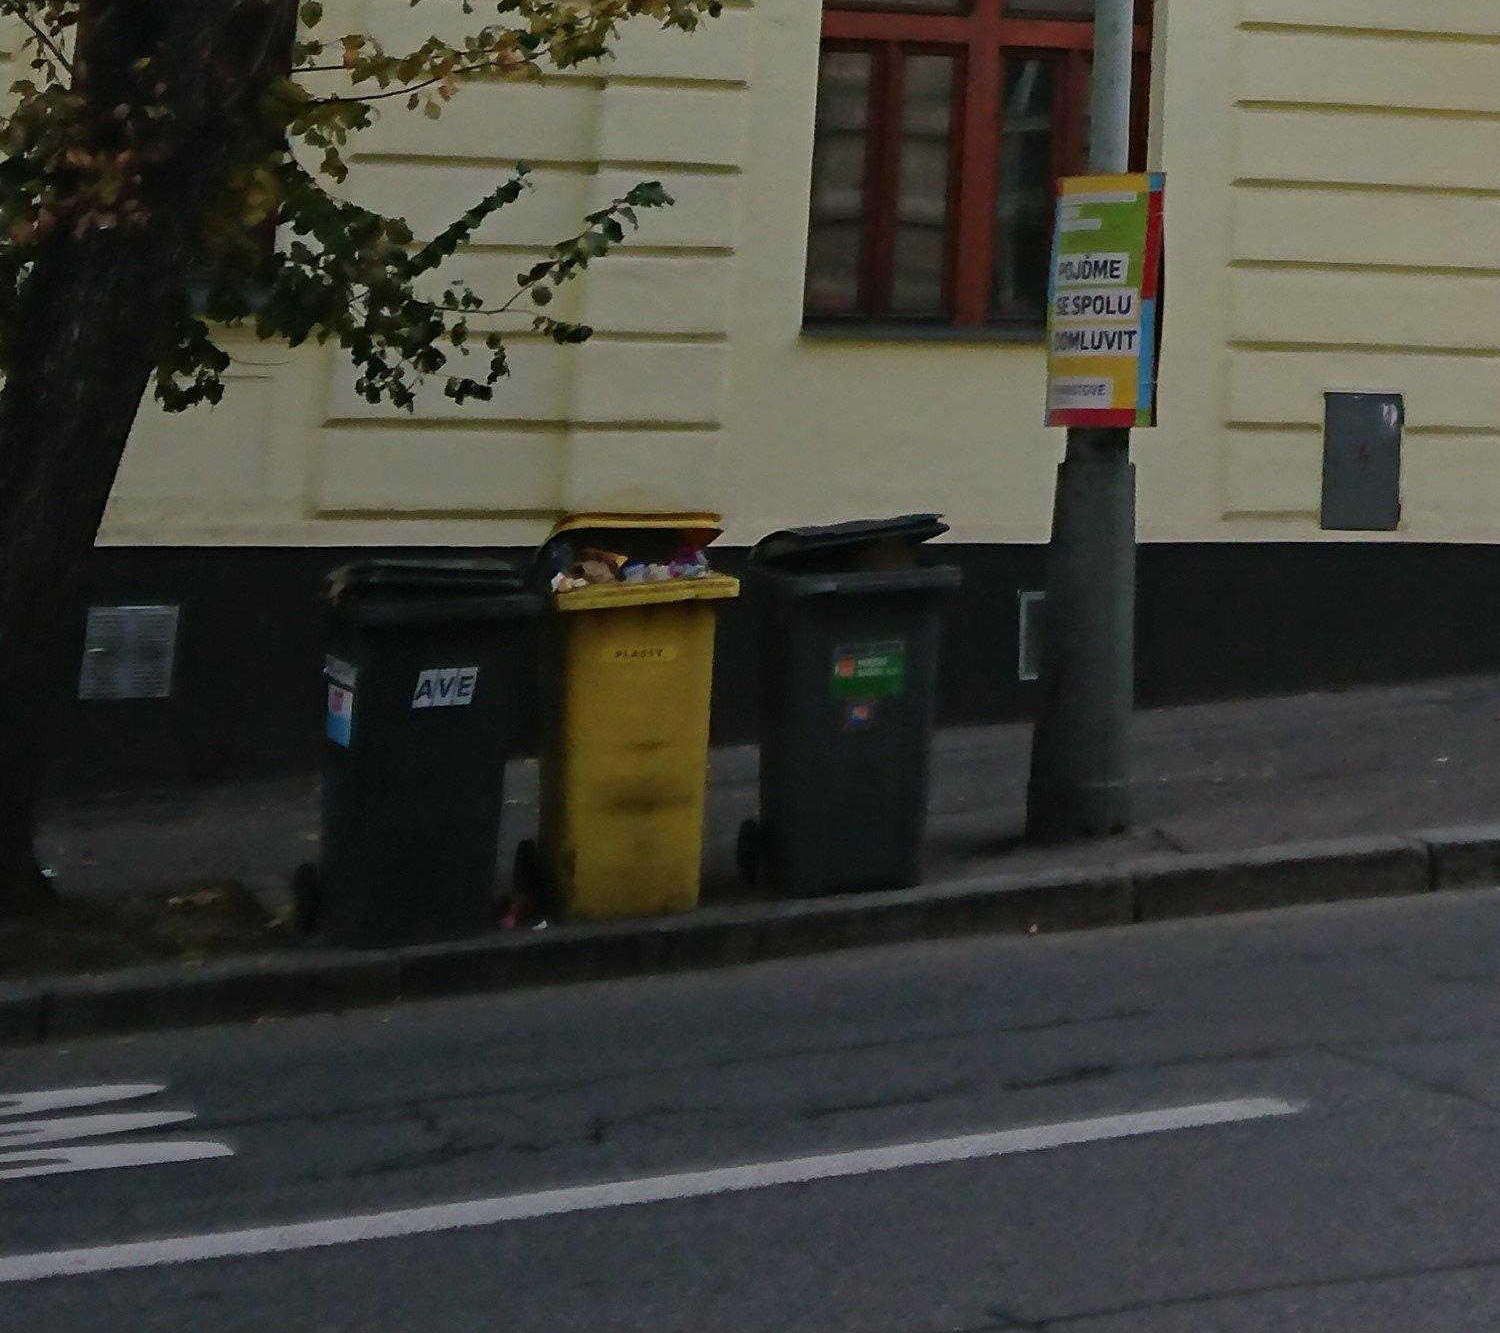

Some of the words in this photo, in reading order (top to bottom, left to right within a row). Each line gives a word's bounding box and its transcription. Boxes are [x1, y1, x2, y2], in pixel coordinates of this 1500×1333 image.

[1056, 296, 1069, 316] SE
[1072, 295, 1131, 316] SPOLU
[414, 674, 474, 702] AVE
